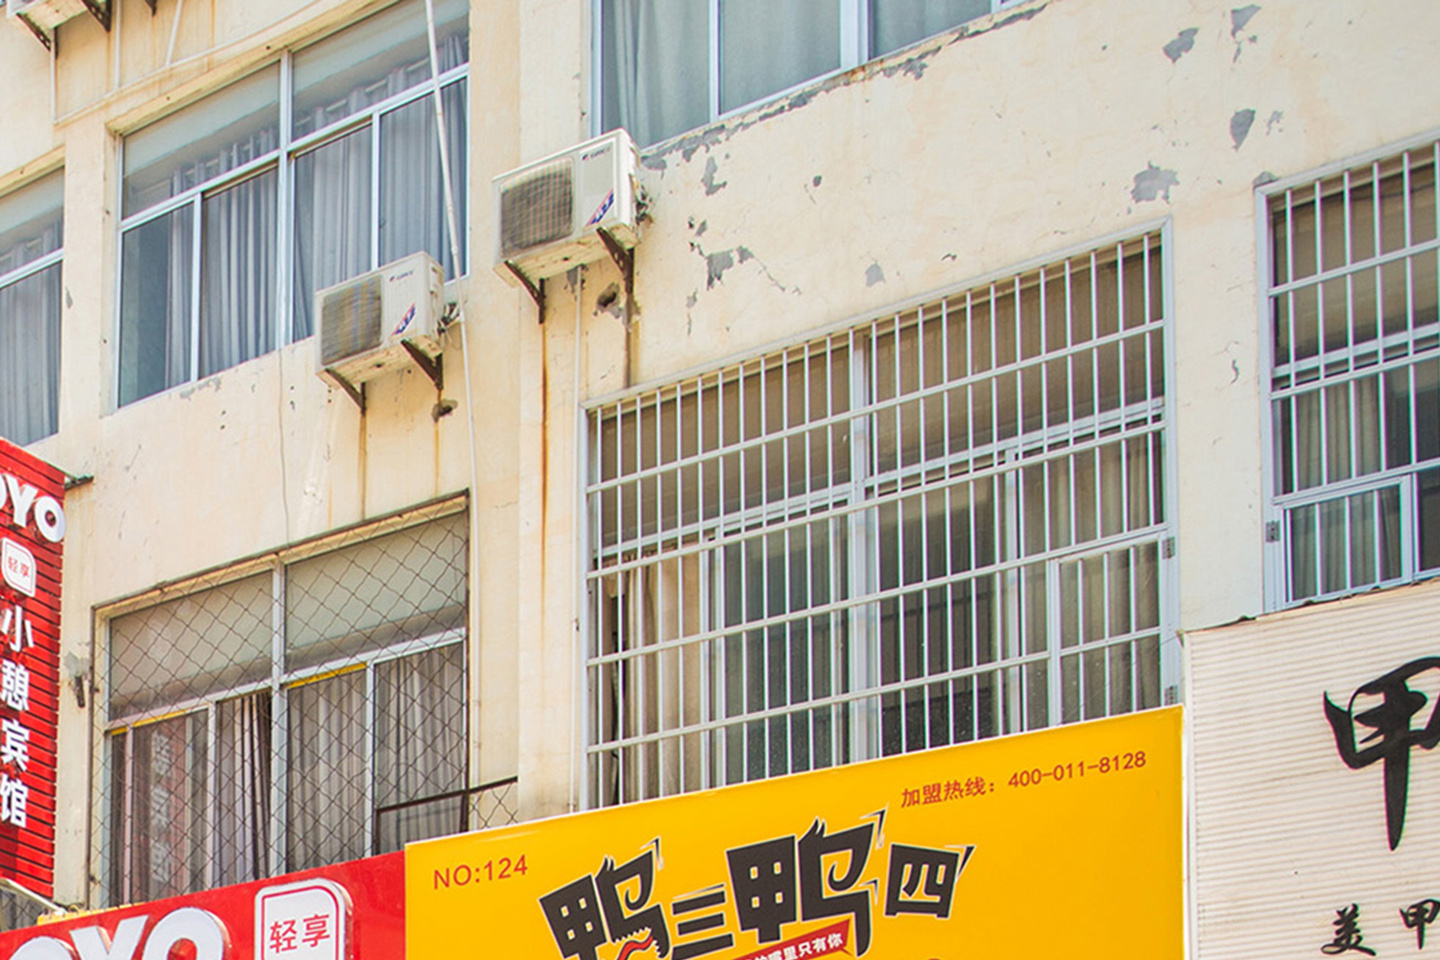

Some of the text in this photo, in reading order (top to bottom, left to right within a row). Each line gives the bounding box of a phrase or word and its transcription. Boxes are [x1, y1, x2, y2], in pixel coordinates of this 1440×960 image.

[0, 604, 35, 829] 小憩宾馆
[1007, 750, 1147, 788] 400-011-8128
[433, 854, 528, 890] NO:124
[269, 913, 331, 954] 轻享
[1320, 899, 1440, 957] 美甲
